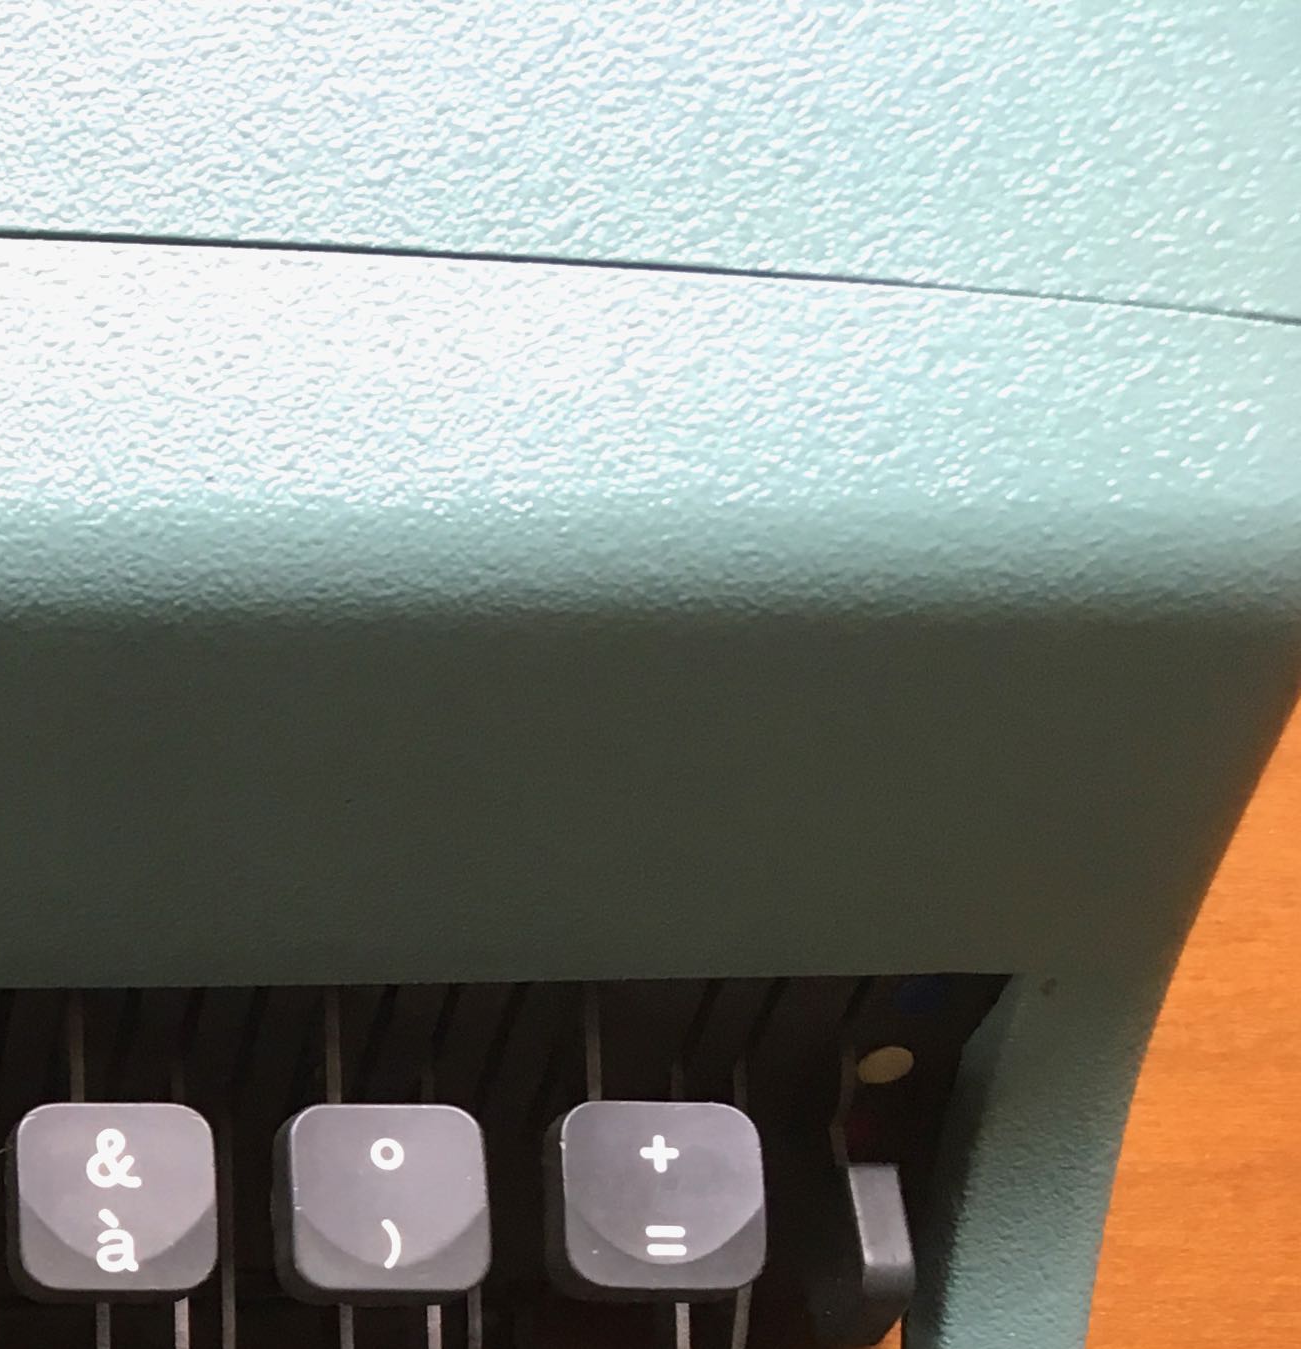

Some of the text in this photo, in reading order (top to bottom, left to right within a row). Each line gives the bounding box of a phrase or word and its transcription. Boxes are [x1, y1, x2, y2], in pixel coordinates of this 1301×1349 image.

[86, 1128, 142, 1189] &
[639, 1134, 680, 1173] +
[96, 1208, 139, 1273] à
[381, 1218, 402, 1269] )
[645, 1225, 687, 1257] =
